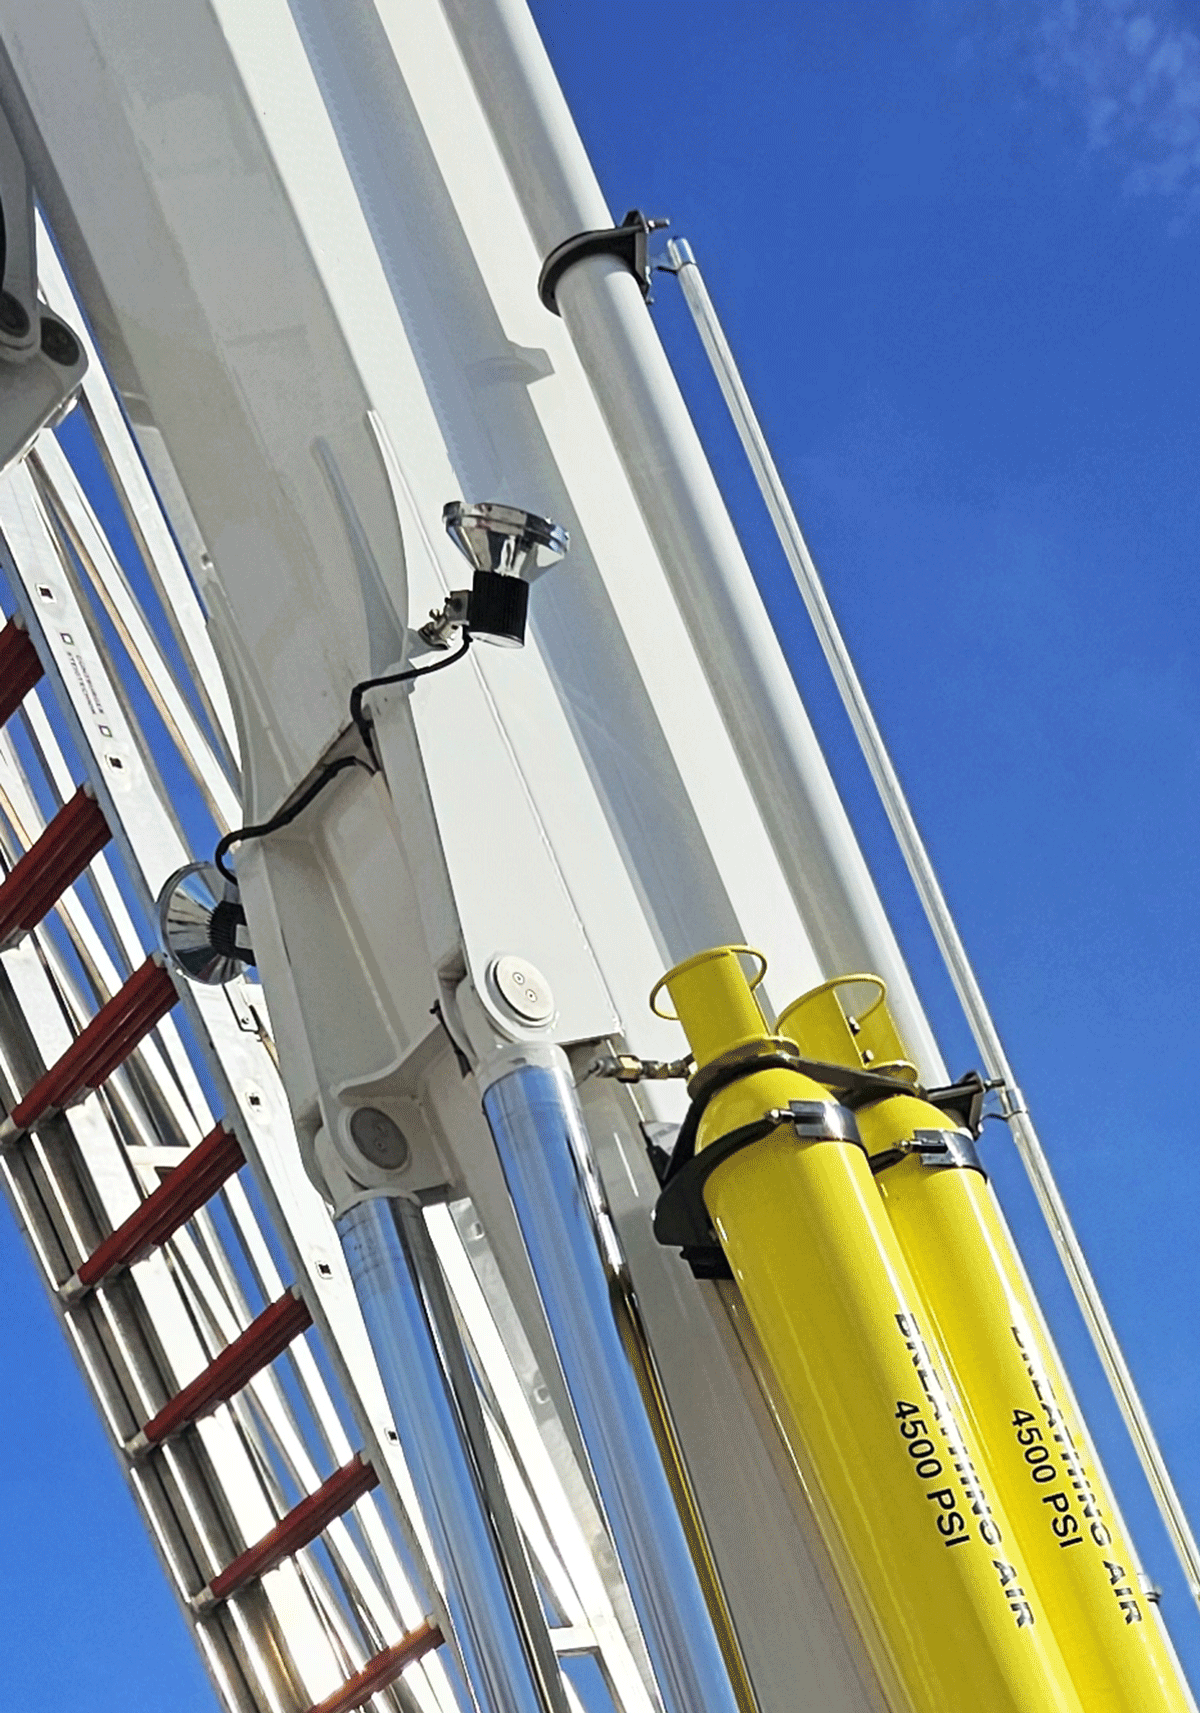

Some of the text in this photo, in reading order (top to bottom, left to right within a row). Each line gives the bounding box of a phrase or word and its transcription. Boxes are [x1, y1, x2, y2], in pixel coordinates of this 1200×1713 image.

[894, 1400, 971, 1548] 4500 PSI
[1011, 1408, 1084, 1549] 4500 PSI
[992, 1559, 1035, 1629] AIR
[1103, 1559, 1143, 1626] AIR
